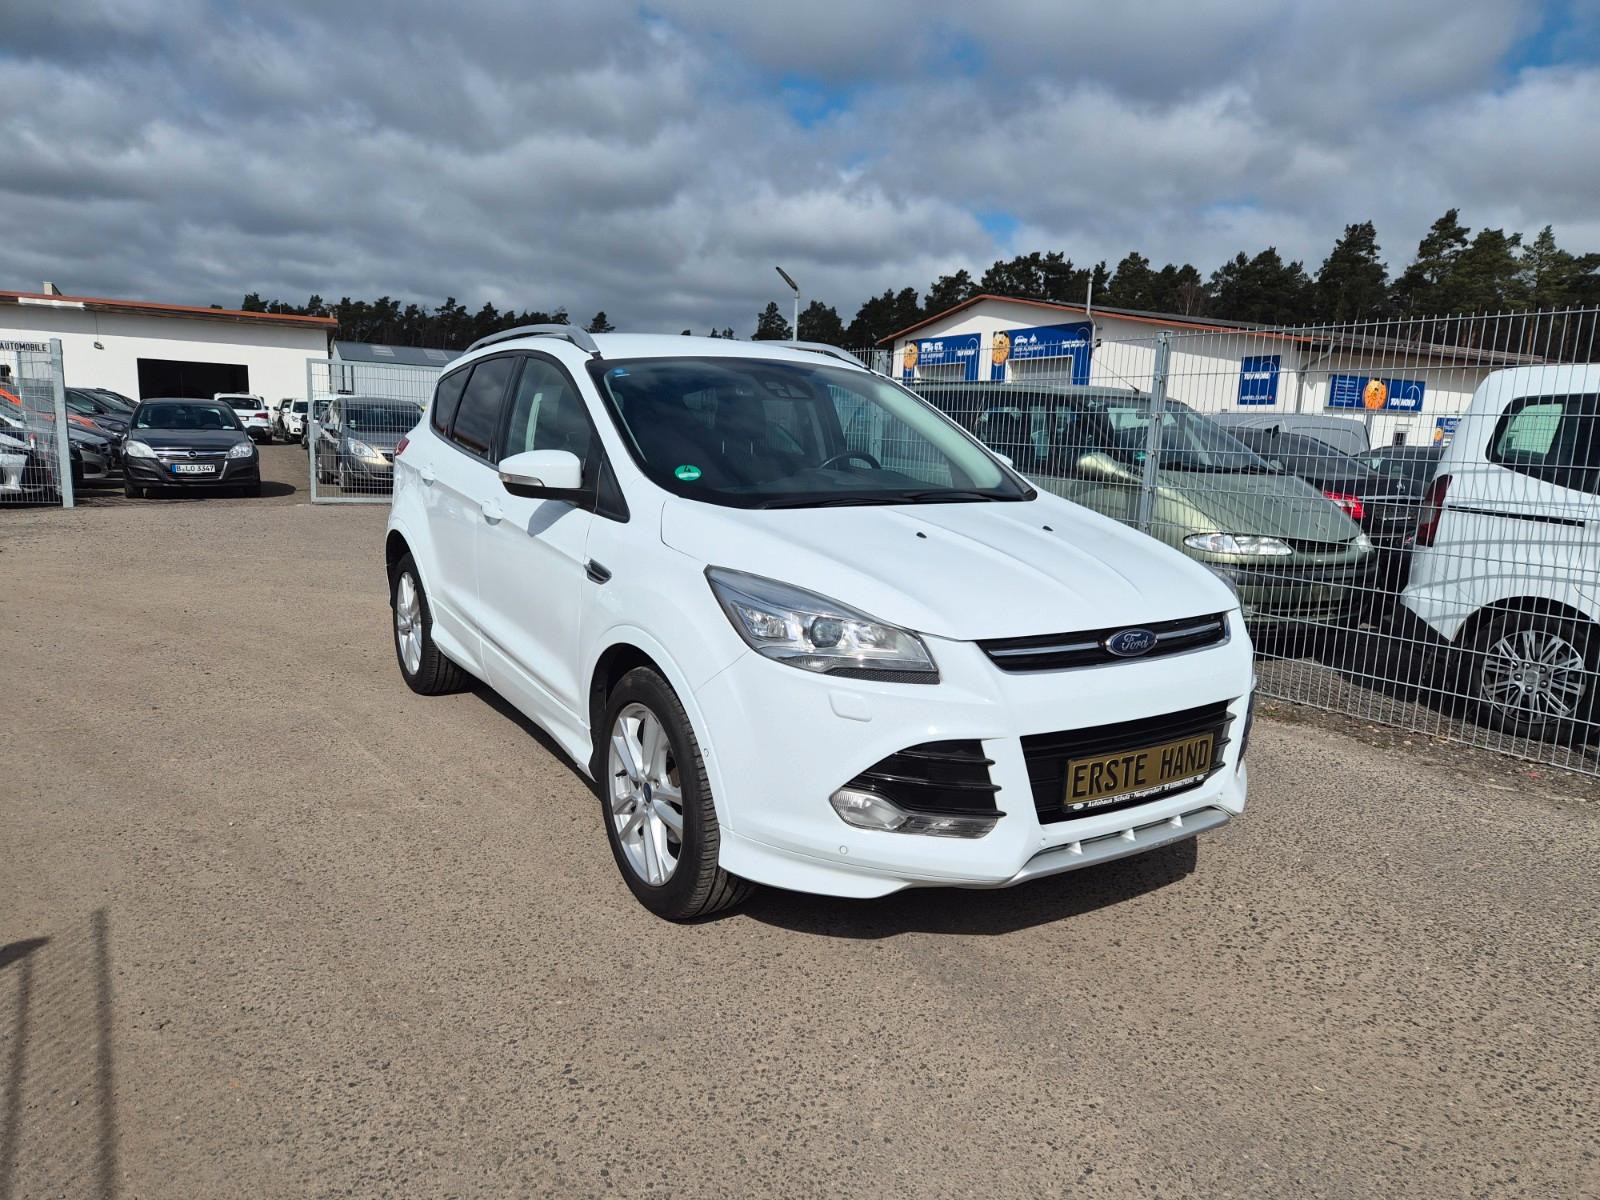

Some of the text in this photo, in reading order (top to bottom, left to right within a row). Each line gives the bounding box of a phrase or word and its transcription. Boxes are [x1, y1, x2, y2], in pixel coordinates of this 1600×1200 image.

[0, 341, 47, 352] AUTOMOBILE
[1121, 633, 1149, 651] Ford
[1072, 739, 1210, 798] ERSTE HAND
